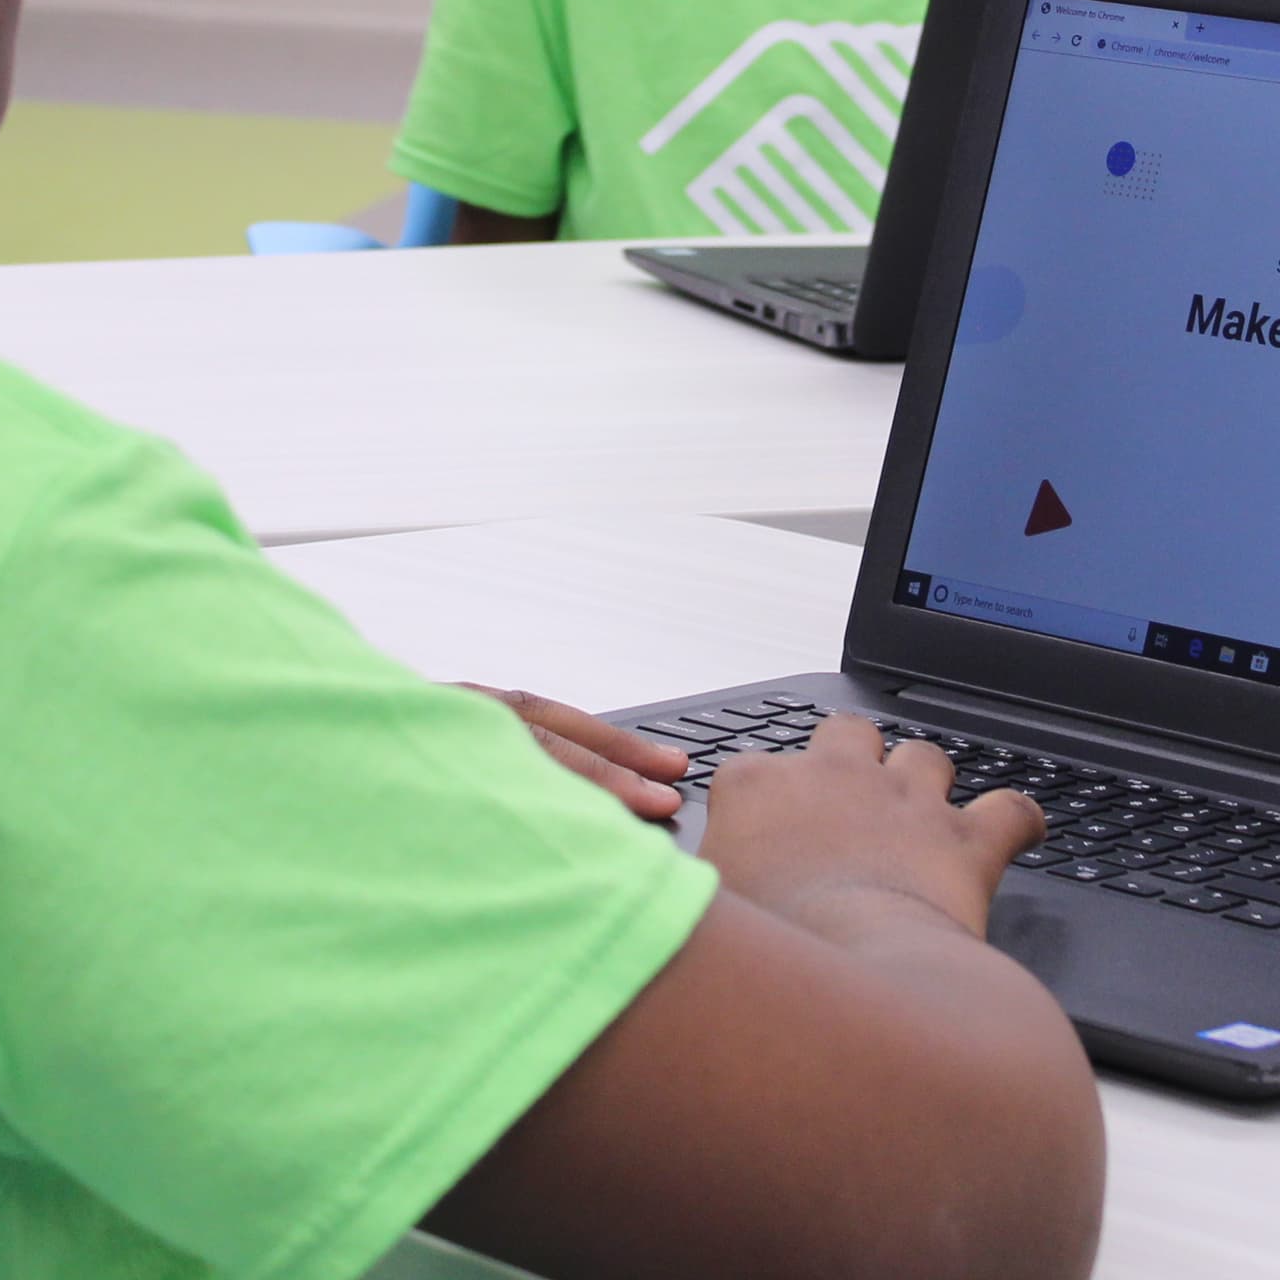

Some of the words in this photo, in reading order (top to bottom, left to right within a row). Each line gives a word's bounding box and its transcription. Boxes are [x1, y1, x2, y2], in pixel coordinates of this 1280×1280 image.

[1056, 5, 1087, 18] Welcome
[1089, 9, 1096, 18] to
[1098, 11, 1125, 22] Chrome
[1111, 41, 1144, 54] Chrome
[953, 592, 972, 605] Type
[974, 597, 993, 609] here
[994, 602, 1005, 612] to
[1006, 605, 1033, 618] search
